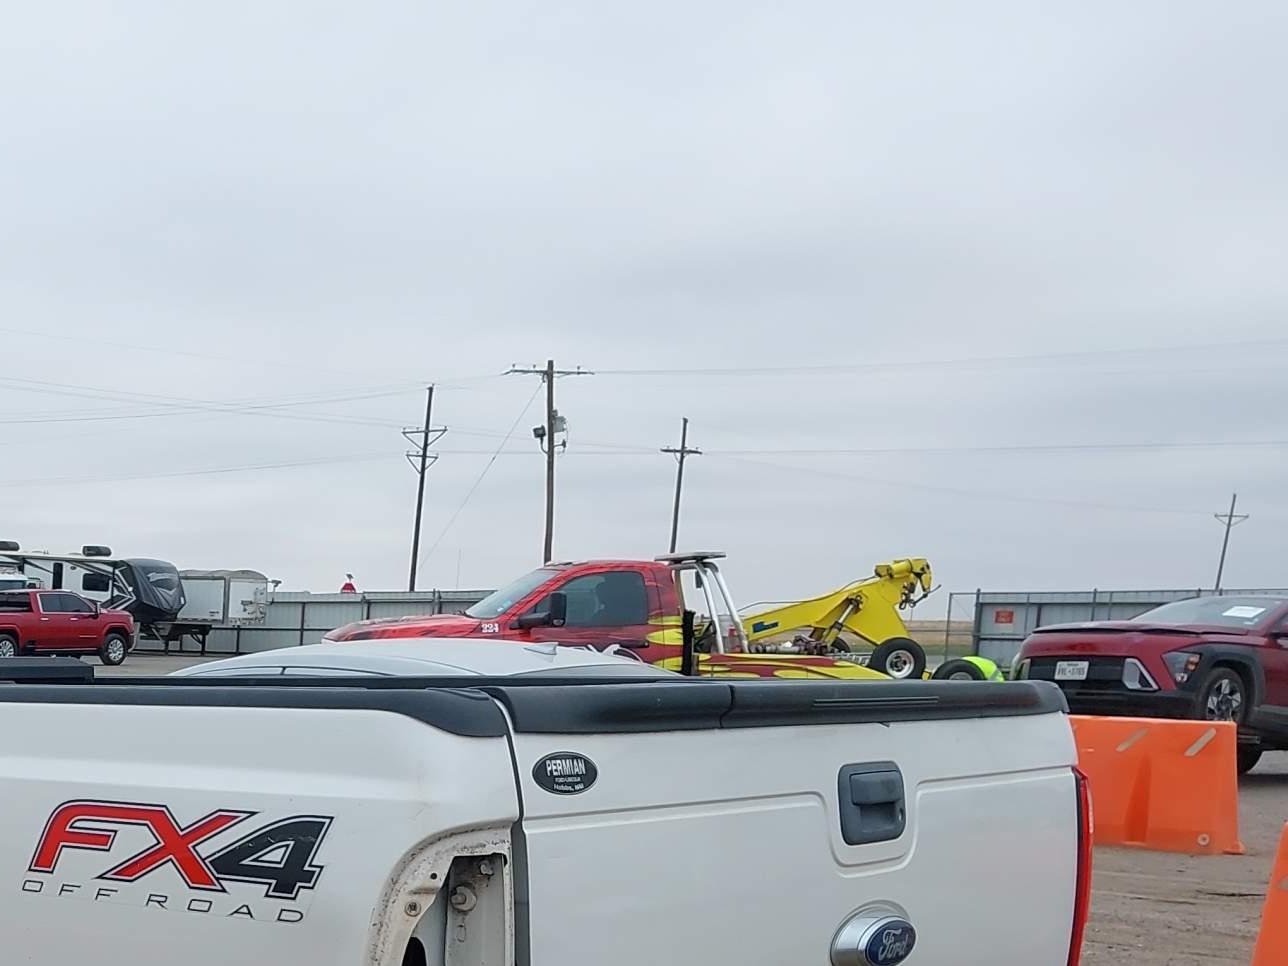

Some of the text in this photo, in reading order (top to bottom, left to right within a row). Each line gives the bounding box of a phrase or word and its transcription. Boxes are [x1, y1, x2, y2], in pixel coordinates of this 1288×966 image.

[545, 758, 586, 776] PERMIAN
[26, 799, 336, 900] FX4
[21, 879, 306, 924] OFF ROAD
[878, 928, 910, 961] Ford
